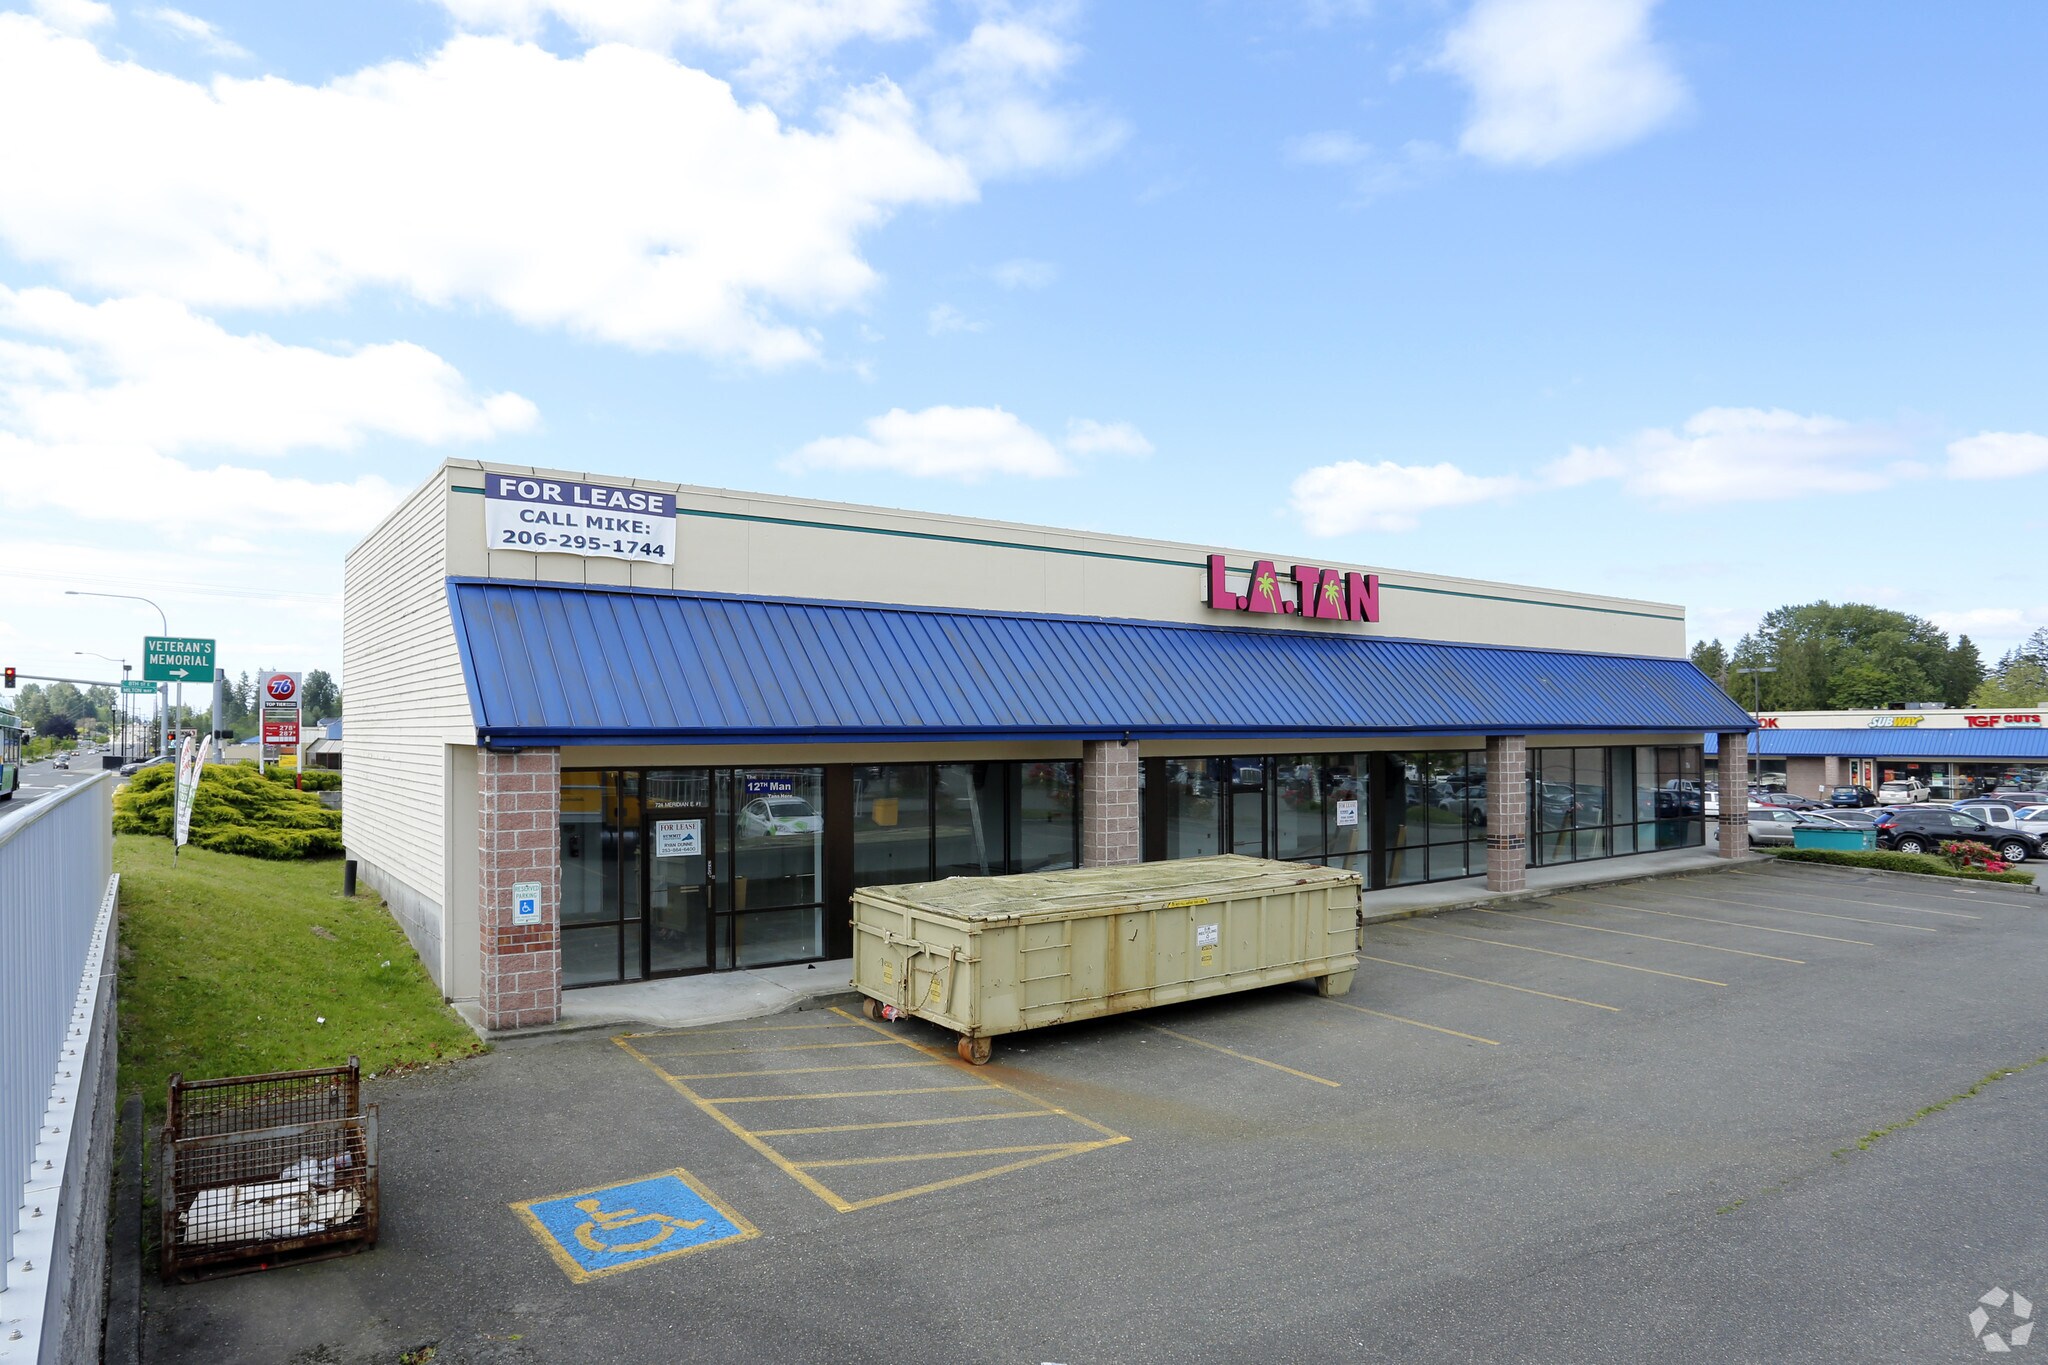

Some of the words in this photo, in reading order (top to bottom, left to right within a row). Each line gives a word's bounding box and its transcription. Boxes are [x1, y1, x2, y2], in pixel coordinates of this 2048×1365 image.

[500, 478, 563, 502] FOR
[574, 486, 664, 514] LEASE
[519, 509, 578, 527] CALL
[586, 515, 651, 535] MIKE:
[502, 529, 666, 558] 206-295-1744
[148, 640, 211, 653] VETERAN'S
[149, 654, 209, 666] MEMORIAL
[271, 679, 292, 694] 76
[1868, 715, 1924, 728] SUBWAY
[1964, 716, 2001, 727] TGF
[747, 782, 768, 791] 12TH
[770, 782, 791, 791] Man
[676, 823, 696, 831] LEASE
